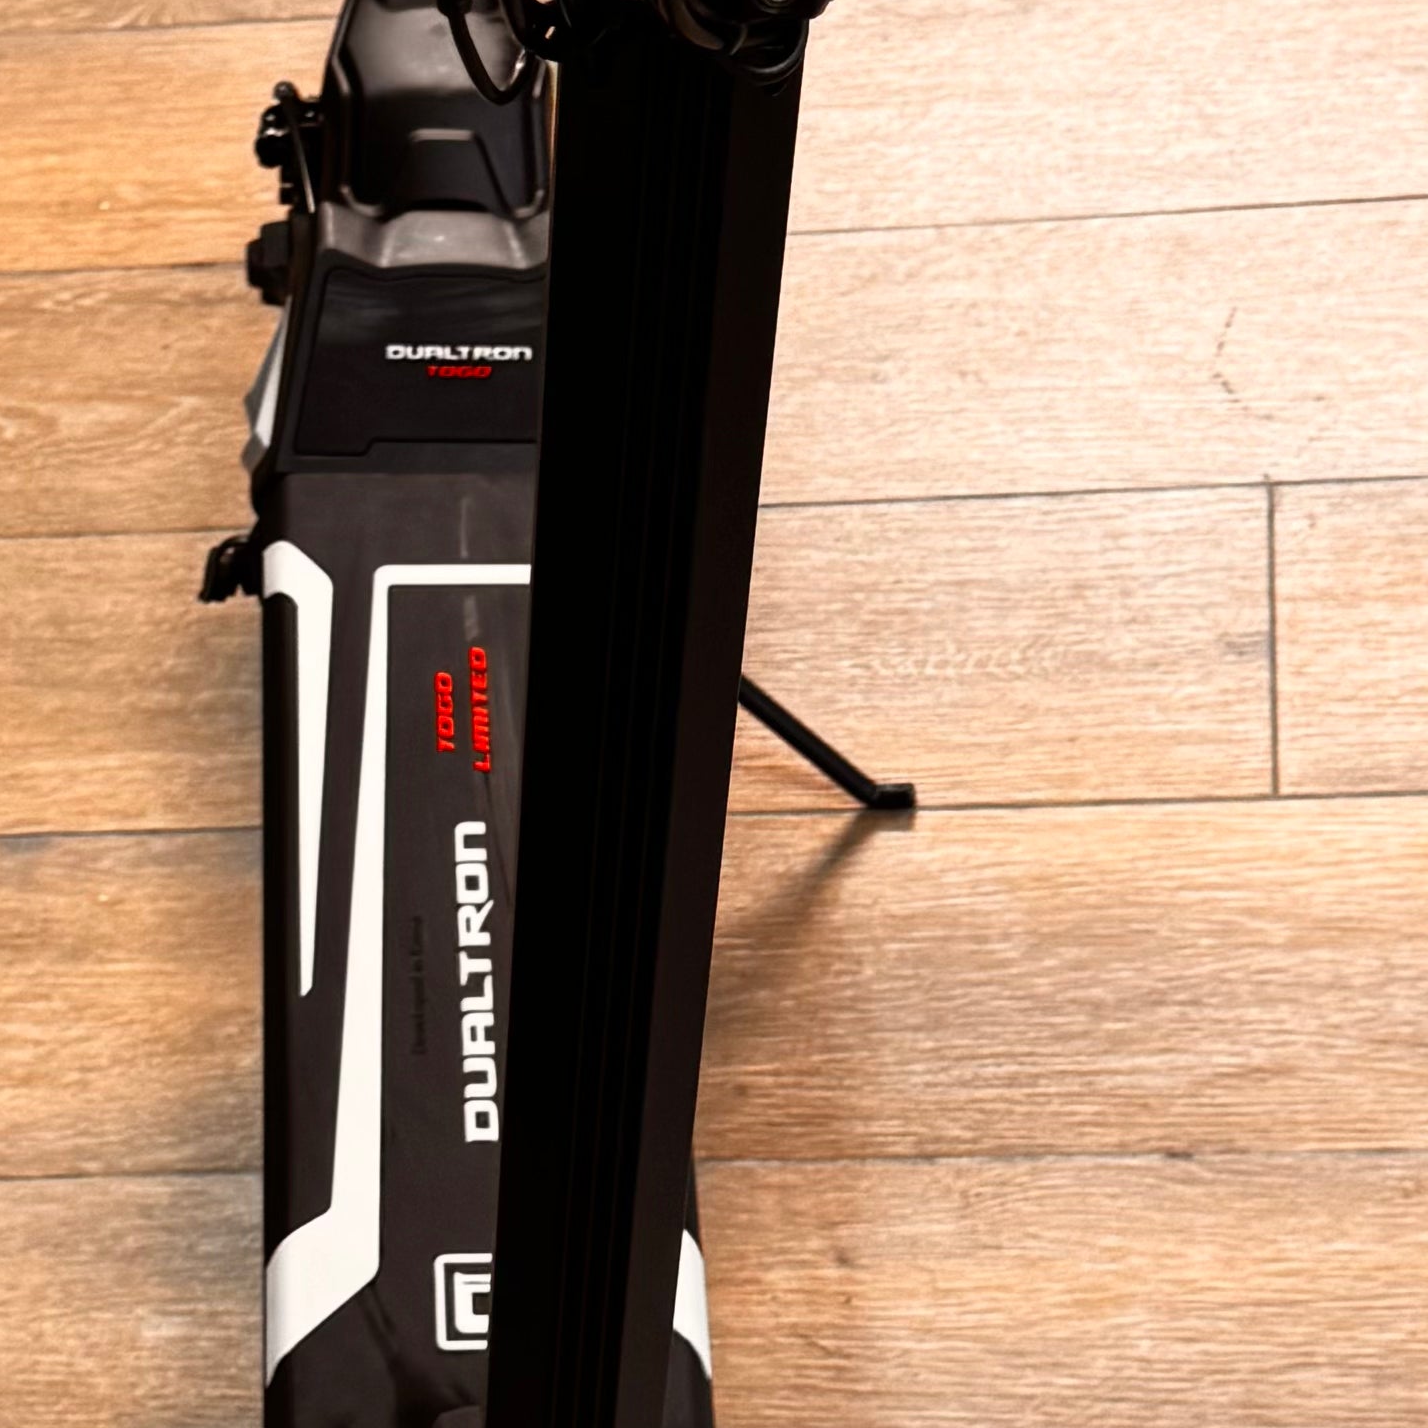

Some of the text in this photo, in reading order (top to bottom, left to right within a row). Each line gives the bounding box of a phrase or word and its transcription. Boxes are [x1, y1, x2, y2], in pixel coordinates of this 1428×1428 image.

[385, 344, 533, 361] DUALTRON
[426, 365, 492, 378] TOGO
[434, 671, 455, 753] TOGO
[468, 646, 491, 773] LIMITED
[454, 821, 500, 1142] DUALTRON
